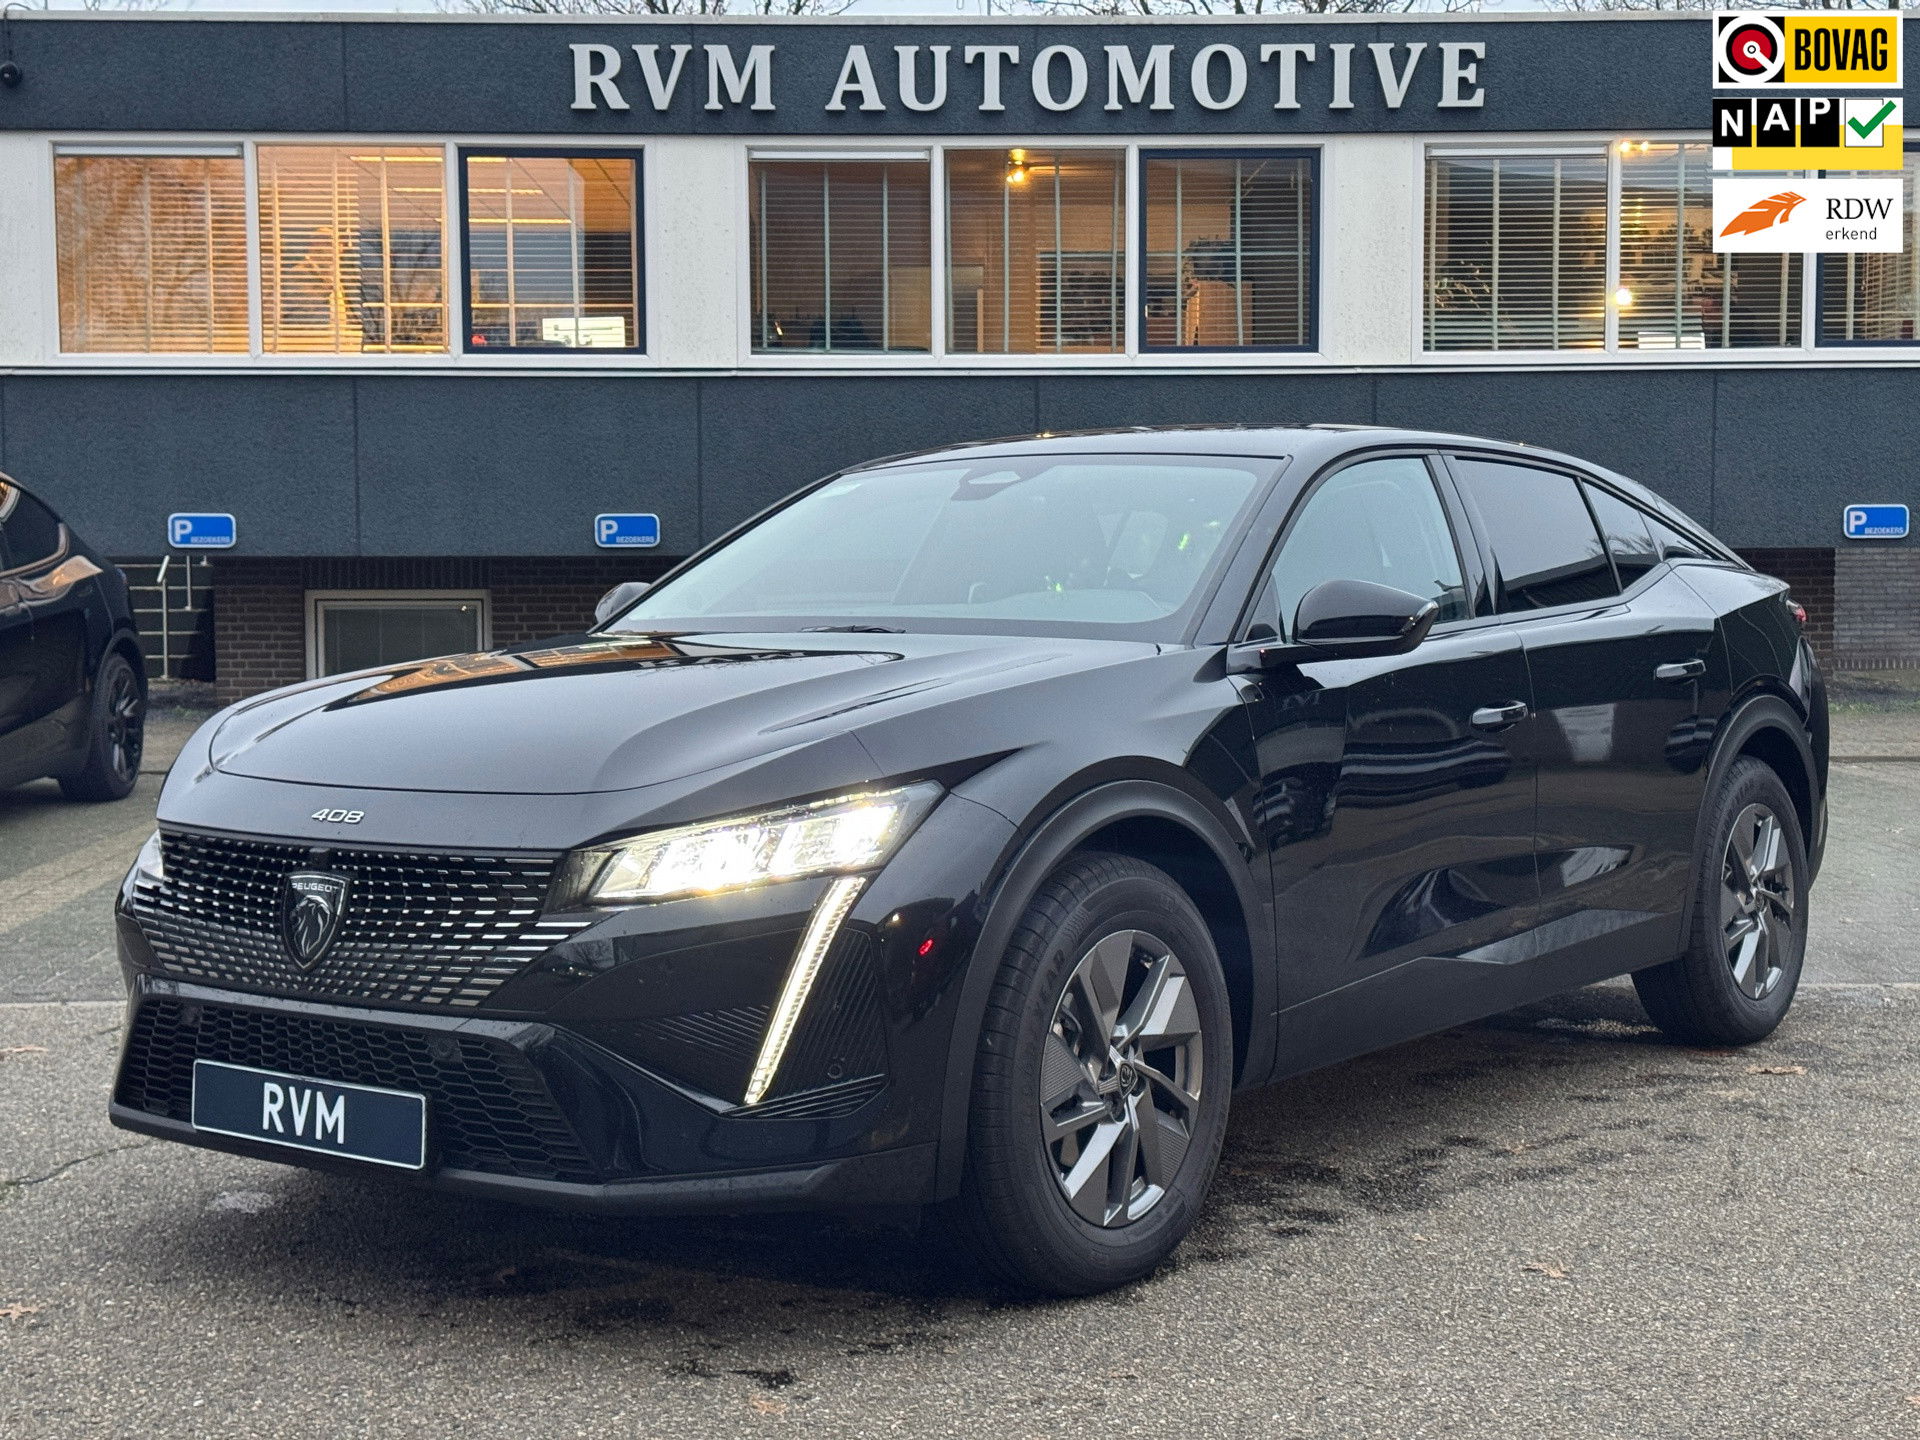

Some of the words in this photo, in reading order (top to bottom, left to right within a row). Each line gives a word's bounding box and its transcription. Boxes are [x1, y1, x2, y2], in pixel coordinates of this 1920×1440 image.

[568, 43, 776, 111] RVM
[824, 41, 1486, 112] AUTOMOTIVE
[174, 519, 192, 542] P
[600, 519, 618, 542] P
[1849, 510, 1867, 533] P
[1864, 526, 1904, 535] BEZOEKERS
[311, 808, 365, 824] 408
[291, 882, 341, 894] PEUGEOT
[262, 1081, 345, 1145] RVM
